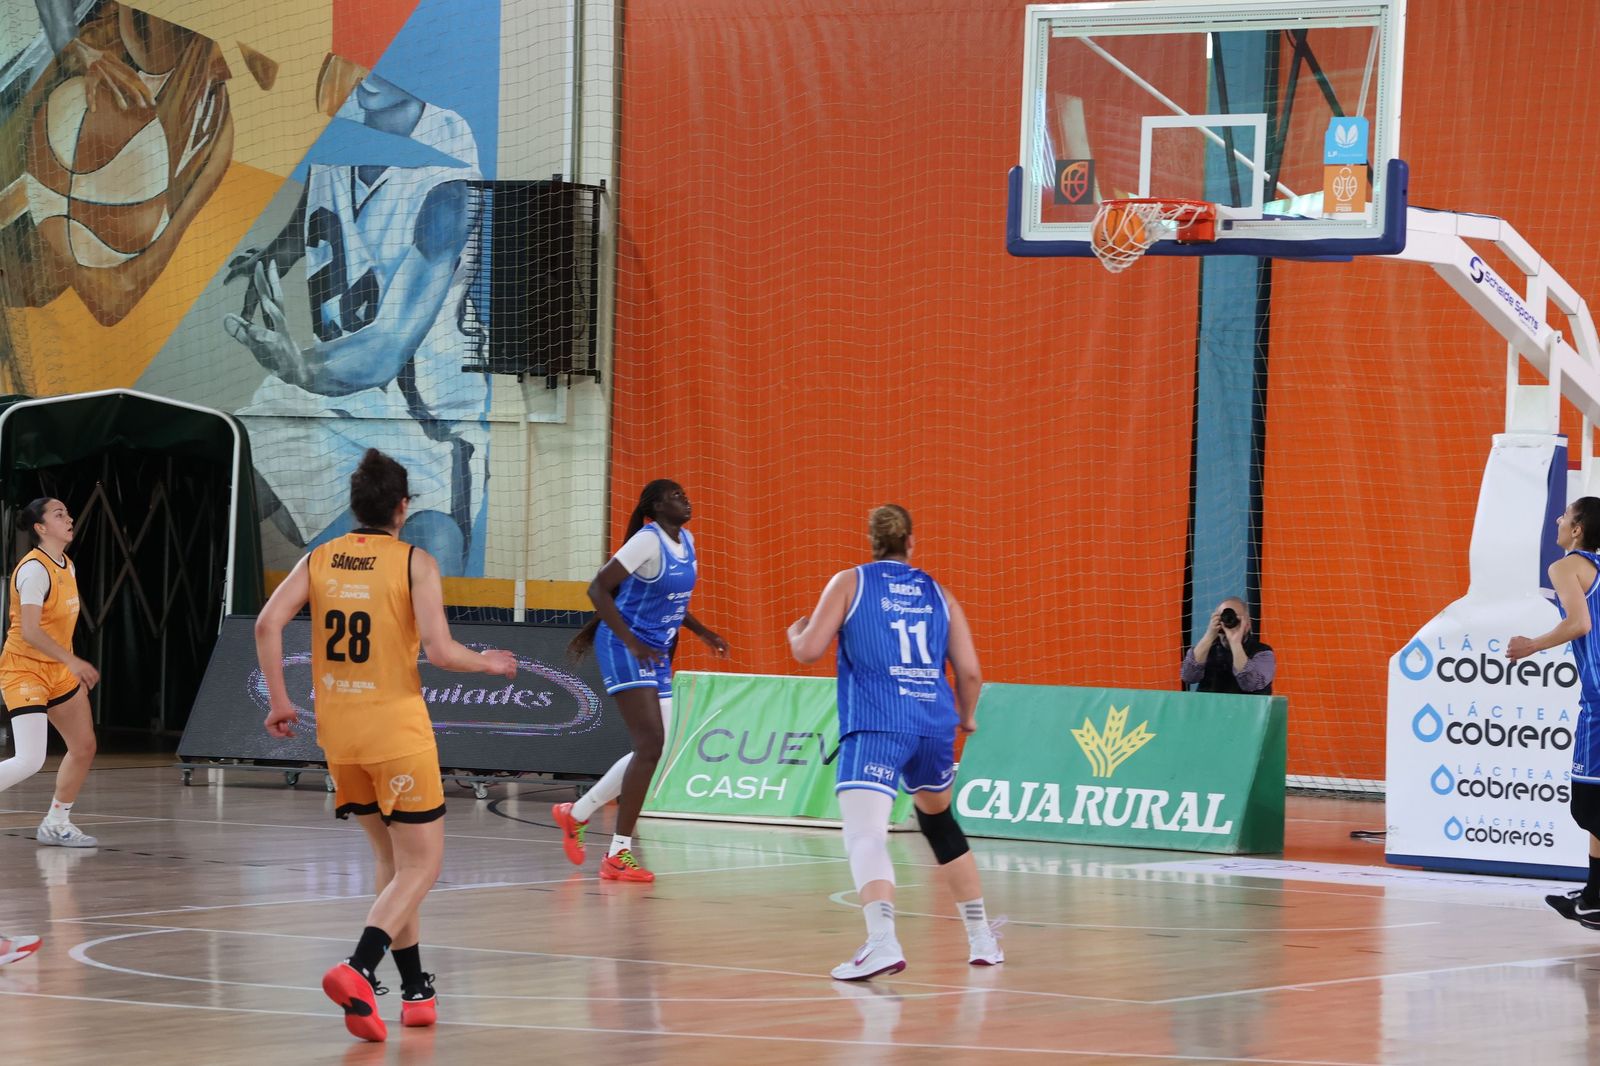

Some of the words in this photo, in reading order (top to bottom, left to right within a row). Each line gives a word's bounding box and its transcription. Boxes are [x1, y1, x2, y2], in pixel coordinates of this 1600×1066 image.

[1514, 300, 1539, 330] Sports
[331, 552, 377, 571] SÁNCHEZ
[325, 609, 372, 664] 28
[890, 619, 933, 665] 11
[1436, 653, 1578, 688] cobrero
[1447, 701, 1570, 722] LÁCTEA
[697, 728, 841, 766] CUEV
[1446, 718, 1573, 751] cobrero
[1457, 762, 1570, 781] LÁCTEAS
[685, 774, 788, 801] CASH
[1456, 777, 1571, 804] cobreros
[955, 778, 1064, 824] CAJA
[1067, 784, 1234, 835] RURAL
[1465, 815, 1555, 830] LÁCTEAS
[1465, 826, 1555, 848] cobreros
